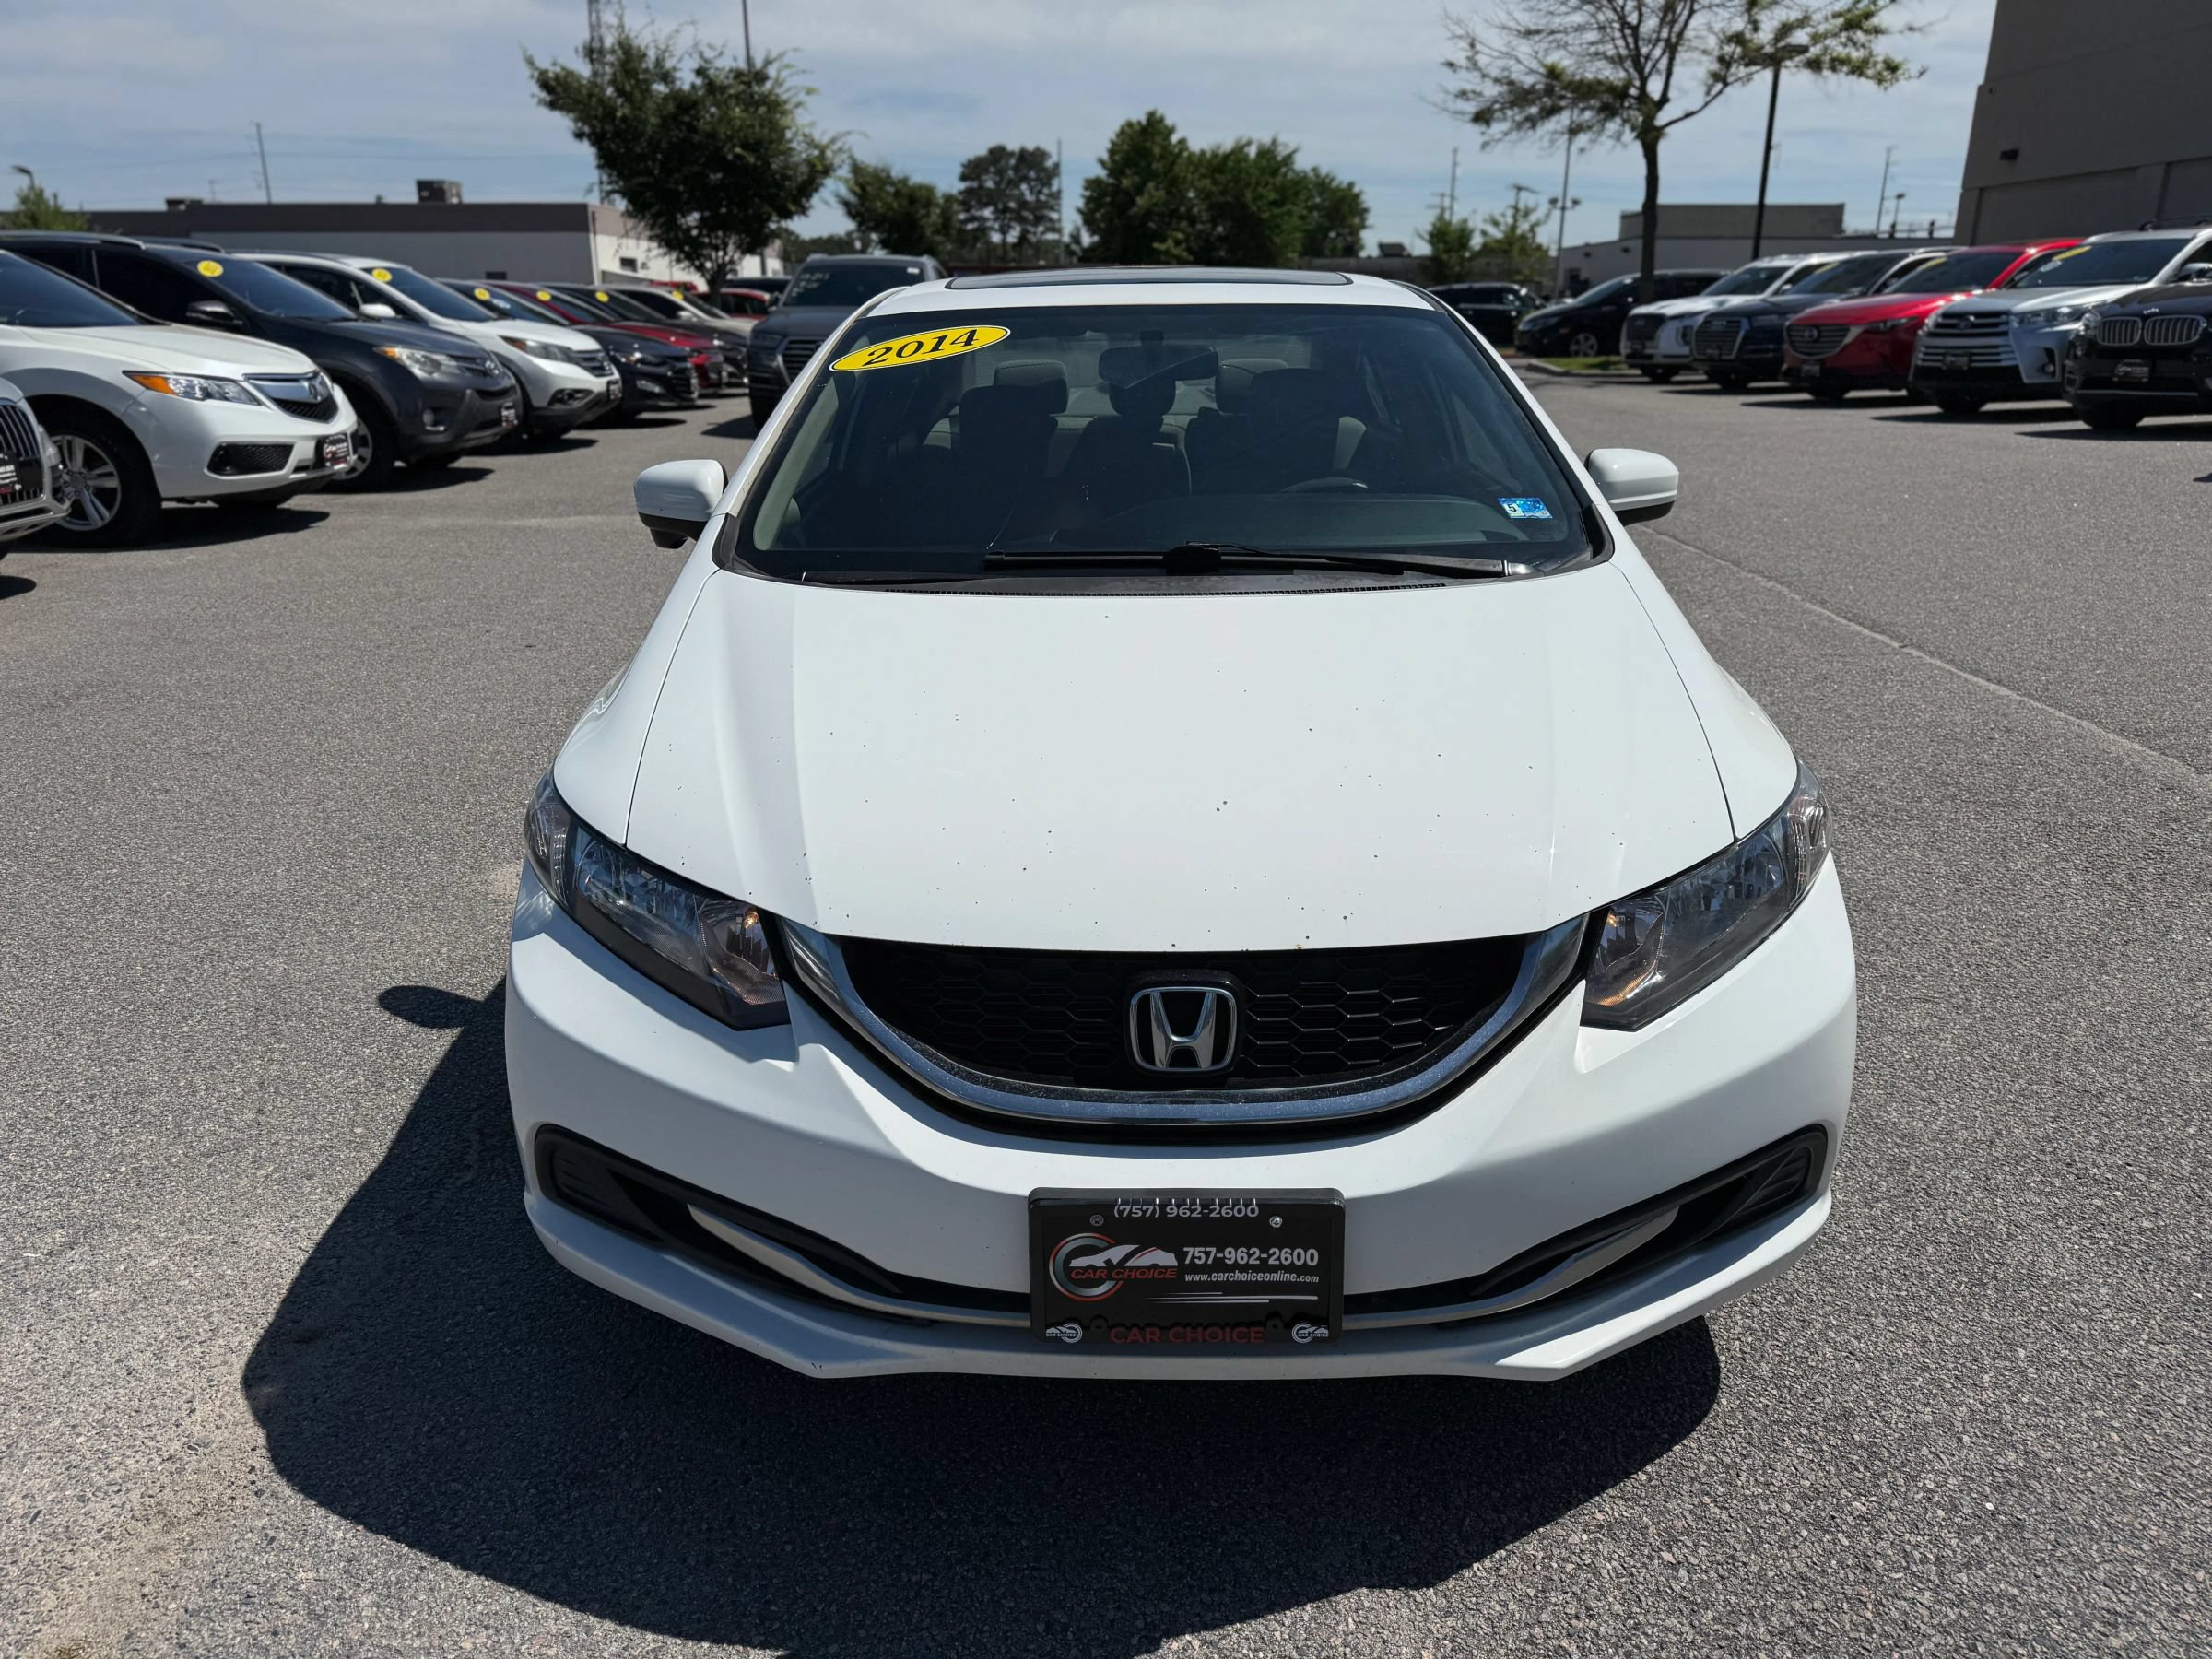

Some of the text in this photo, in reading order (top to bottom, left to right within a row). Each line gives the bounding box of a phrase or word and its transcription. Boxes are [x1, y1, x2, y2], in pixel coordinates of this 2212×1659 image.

[862, 328, 979, 367] 2014
[1507, 504, 1517, 512] 5
[1113, 1205, 1259, 1218] (757) 962-2600
[1182, 1247, 1319, 1266] 757-962-2600
[1071, 1268, 1178, 1279] CAR CHOICE
[1184, 1270, 1320, 1283] www.carchoiceonline.com
[1110, 1326, 1265, 1343] CAR CHOICE
